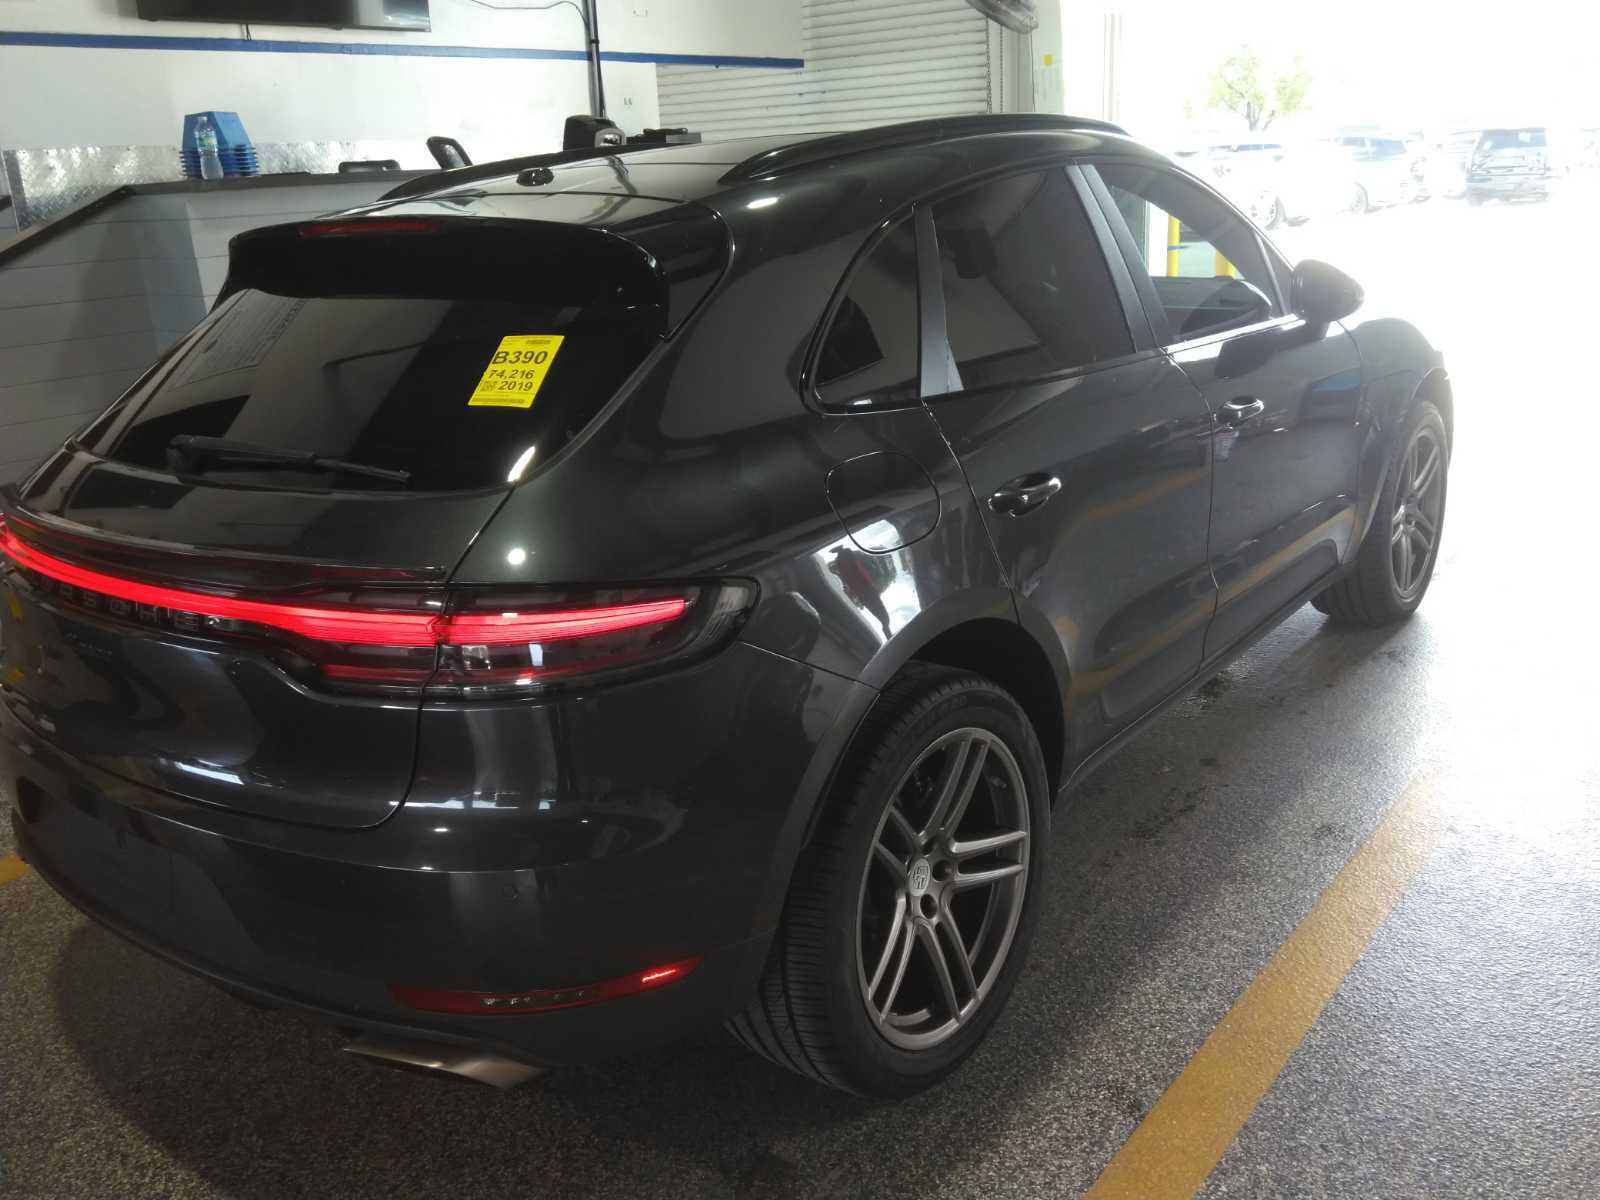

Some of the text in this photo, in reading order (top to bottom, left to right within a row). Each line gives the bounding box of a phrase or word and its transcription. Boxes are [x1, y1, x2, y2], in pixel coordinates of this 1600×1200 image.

[491, 350, 549, 365] B390
[488, 369, 536, 380] 74,216
[497, 380, 533, 392] 2019
[30, 573, 199, 632] RSCHE
